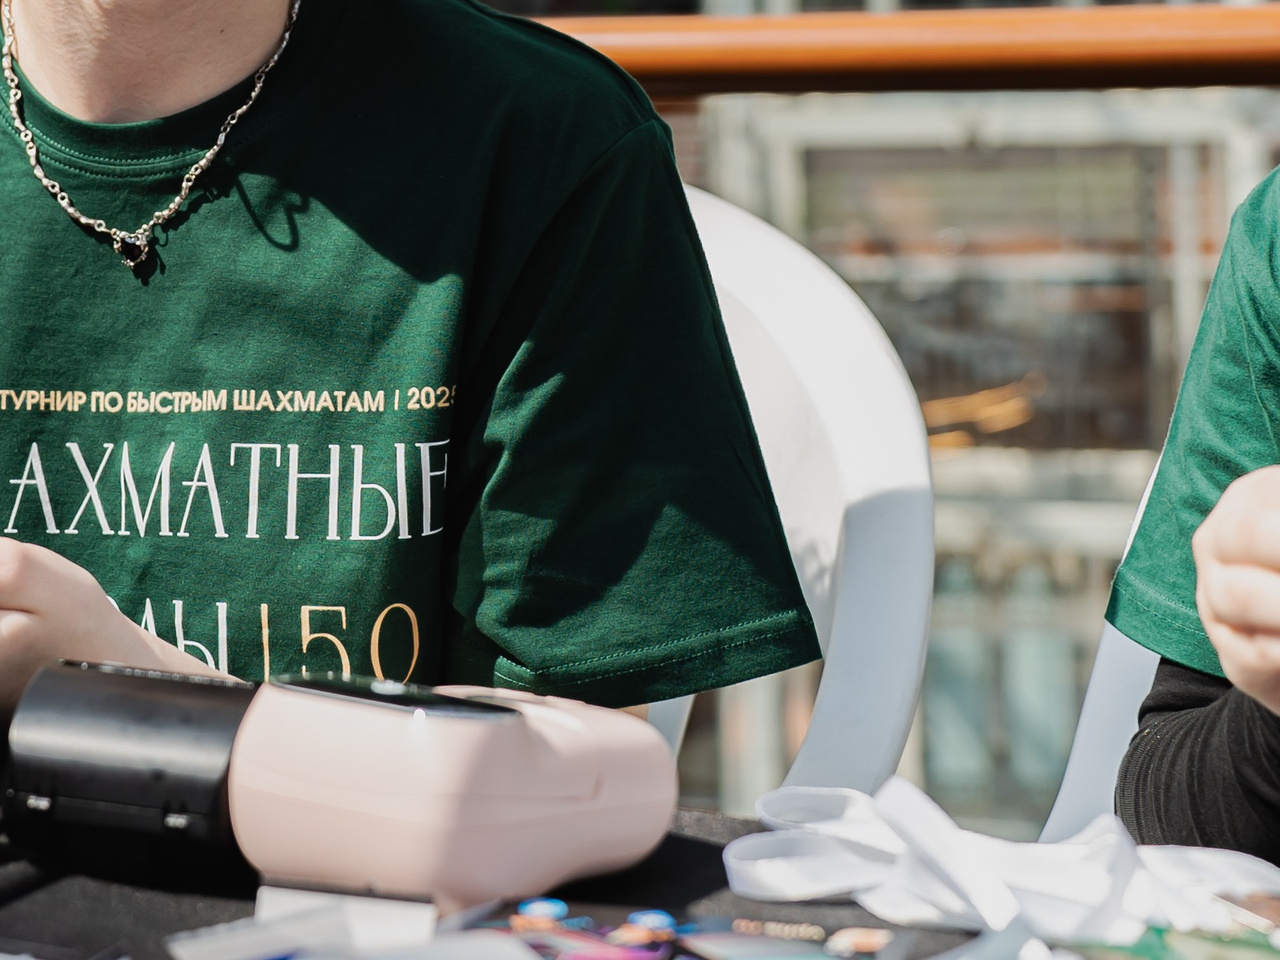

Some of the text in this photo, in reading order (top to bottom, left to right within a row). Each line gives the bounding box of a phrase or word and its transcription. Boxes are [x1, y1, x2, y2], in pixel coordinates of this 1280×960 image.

[90, 390, 124, 413] ПО
[126, 389, 228, 414] БЫСТРЫМ
[233, 389, 385, 413] ШАХМАТАМ
